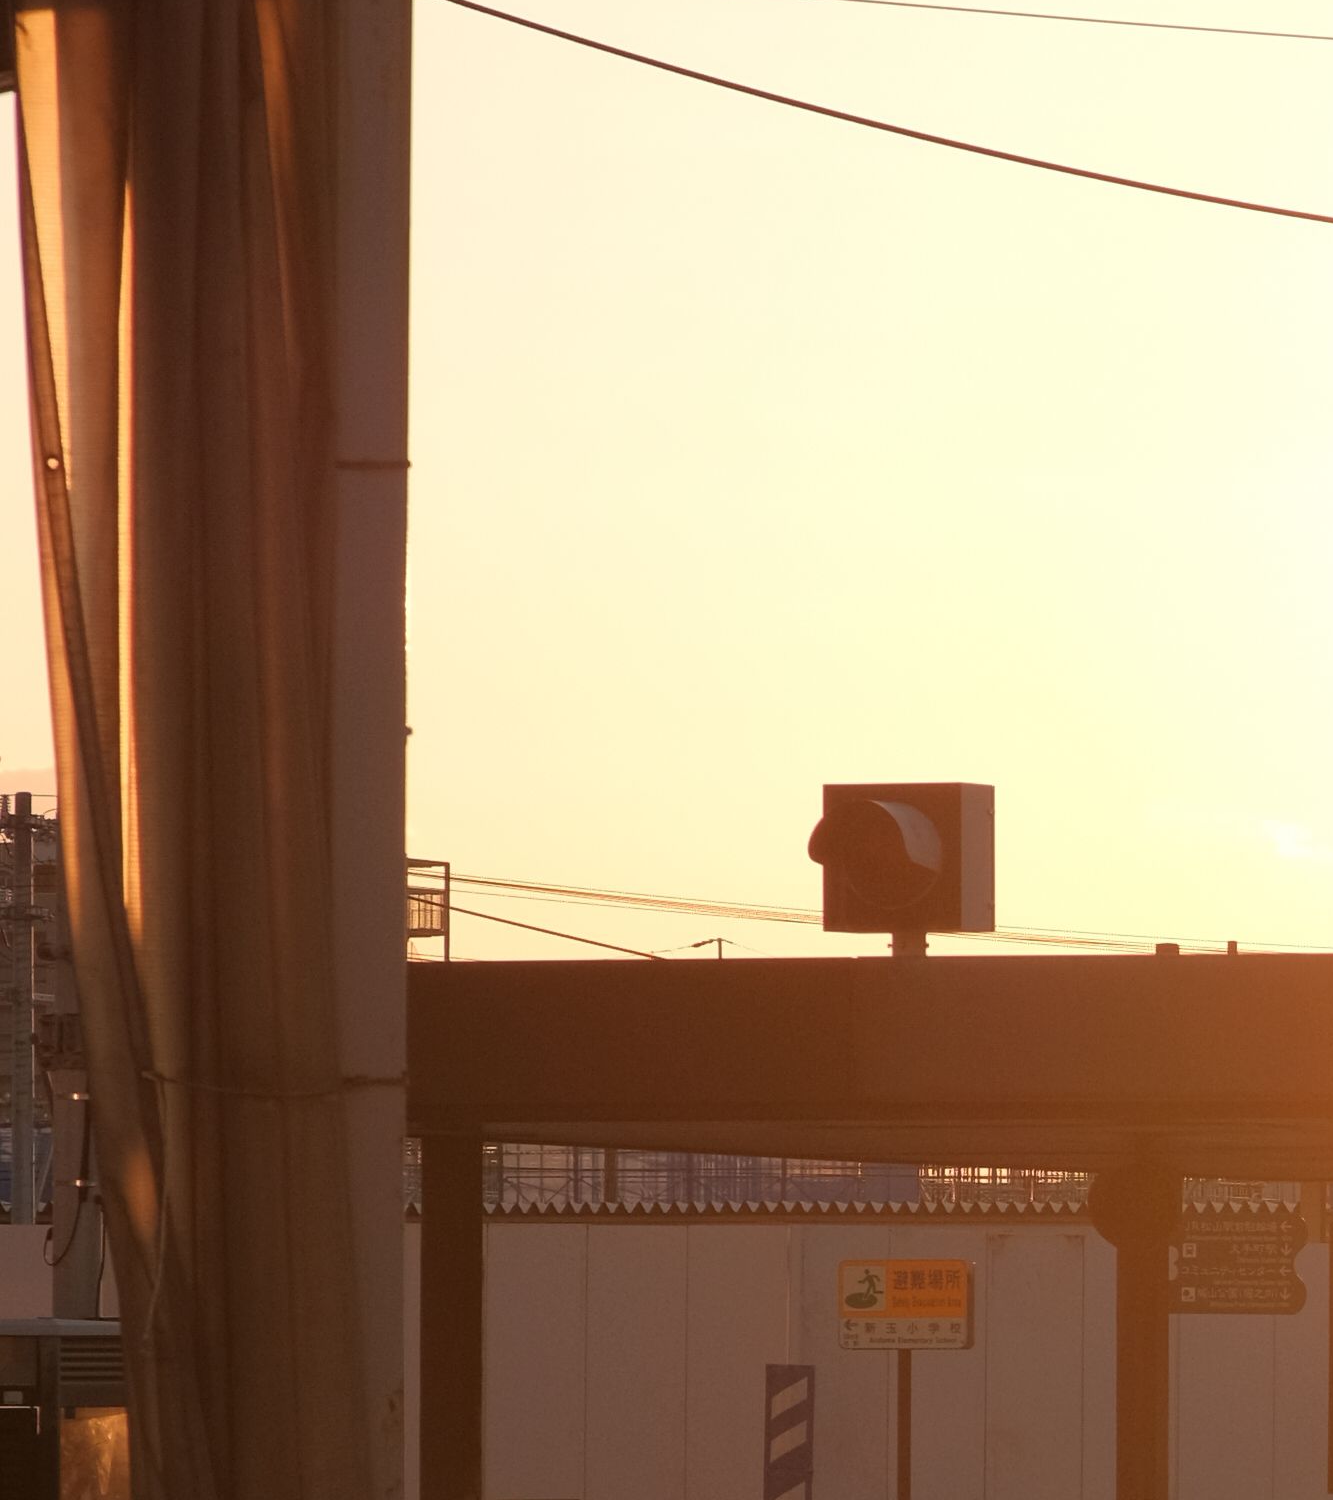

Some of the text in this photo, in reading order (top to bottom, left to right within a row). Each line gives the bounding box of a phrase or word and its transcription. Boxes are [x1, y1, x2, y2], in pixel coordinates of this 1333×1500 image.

[892, 1269, 961, 1291] 避難場所
[864, 1322, 962, 1334] 新玉小学校
